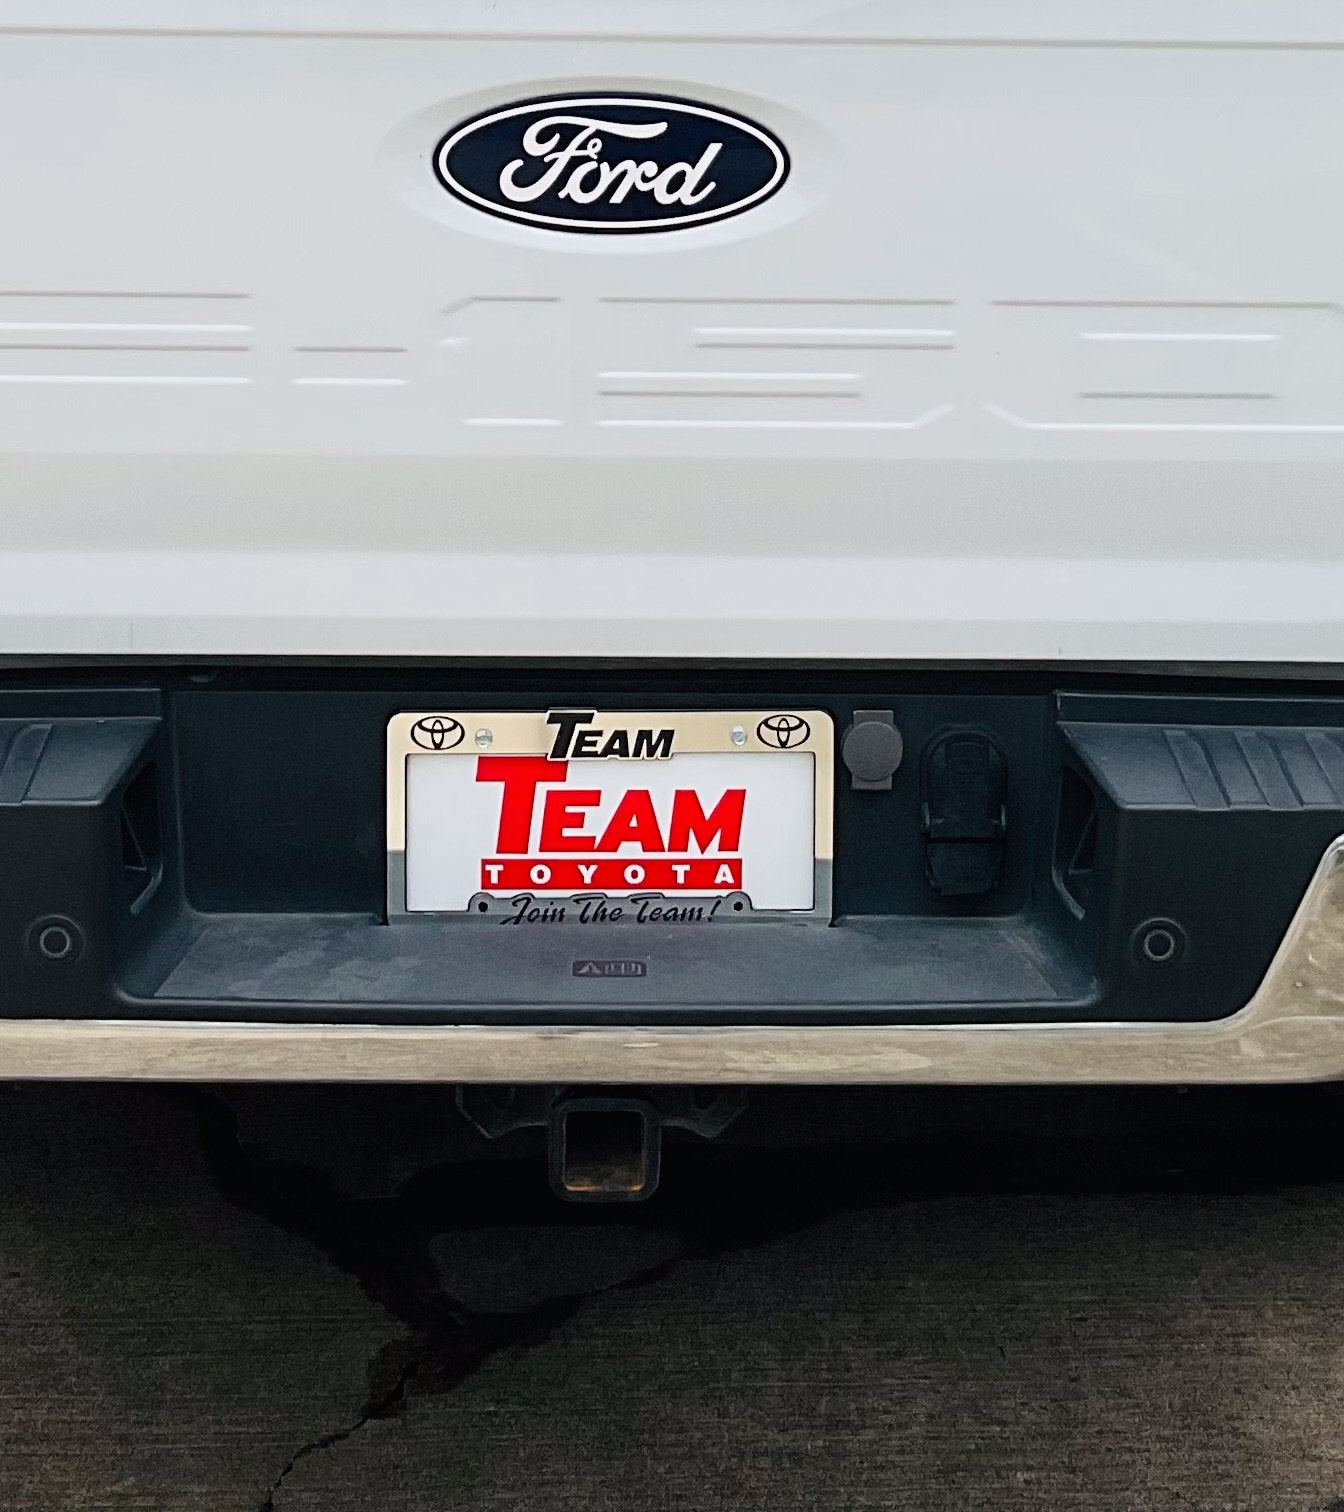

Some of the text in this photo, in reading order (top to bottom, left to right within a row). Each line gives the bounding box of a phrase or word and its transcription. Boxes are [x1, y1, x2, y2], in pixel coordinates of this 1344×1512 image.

[499, 115, 723, 206] Ford
[484, 863, 735, 885] TOYOTA
[499, 896, 721, 925] Join The Team!
